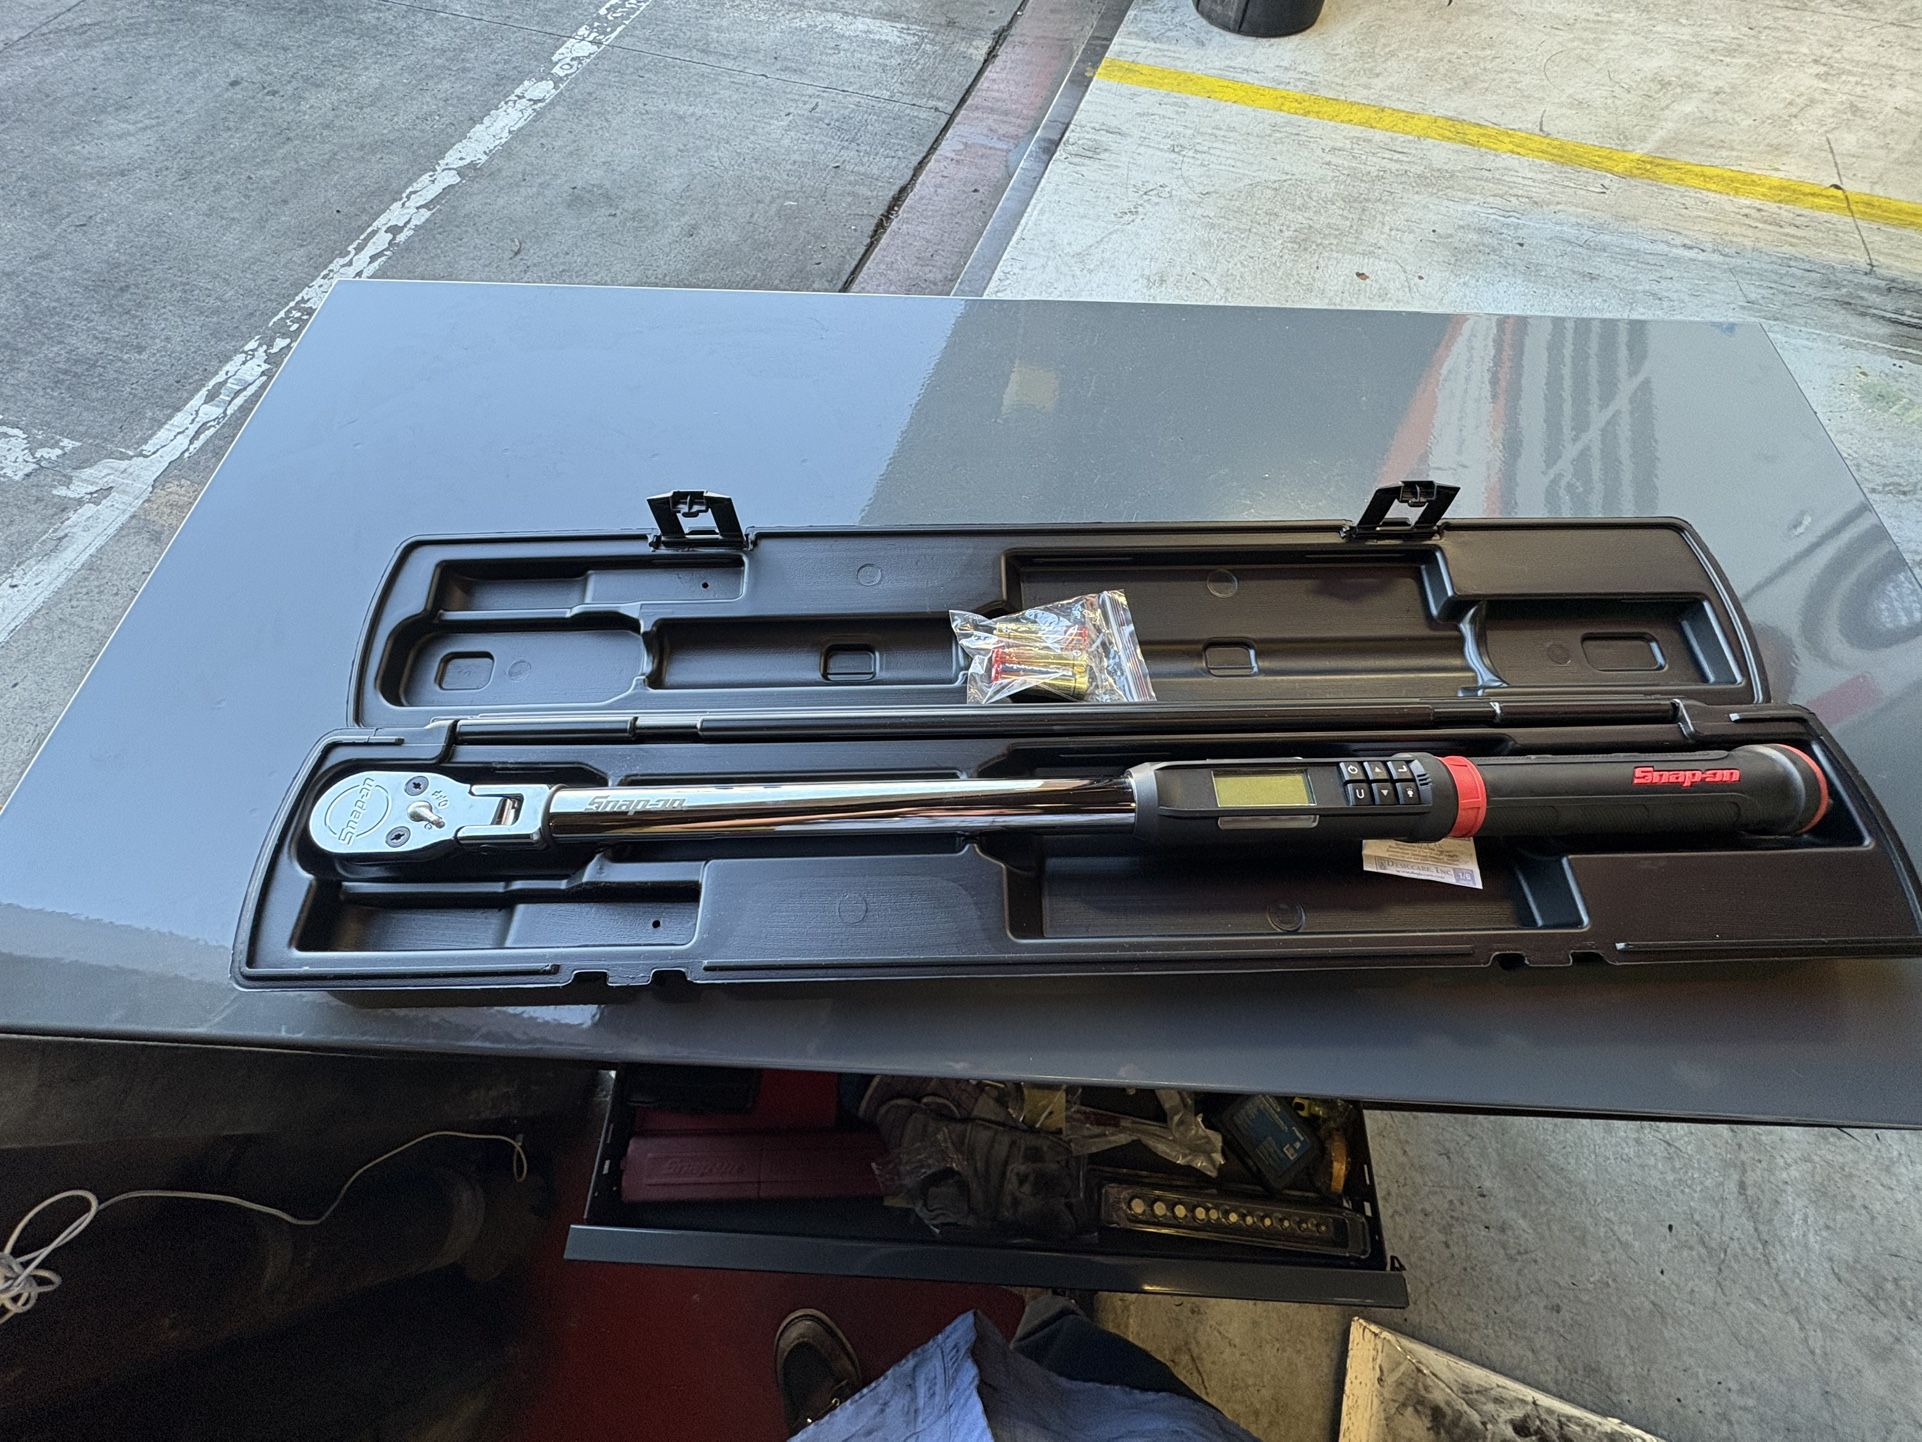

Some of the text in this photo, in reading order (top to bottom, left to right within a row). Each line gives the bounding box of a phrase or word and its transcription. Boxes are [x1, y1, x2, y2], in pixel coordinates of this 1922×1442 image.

[1633, 766, 1740, 787] Snap-on
[338, 777, 375, 845] Snap-on
[584, 795, 688, 816] Snap-on
